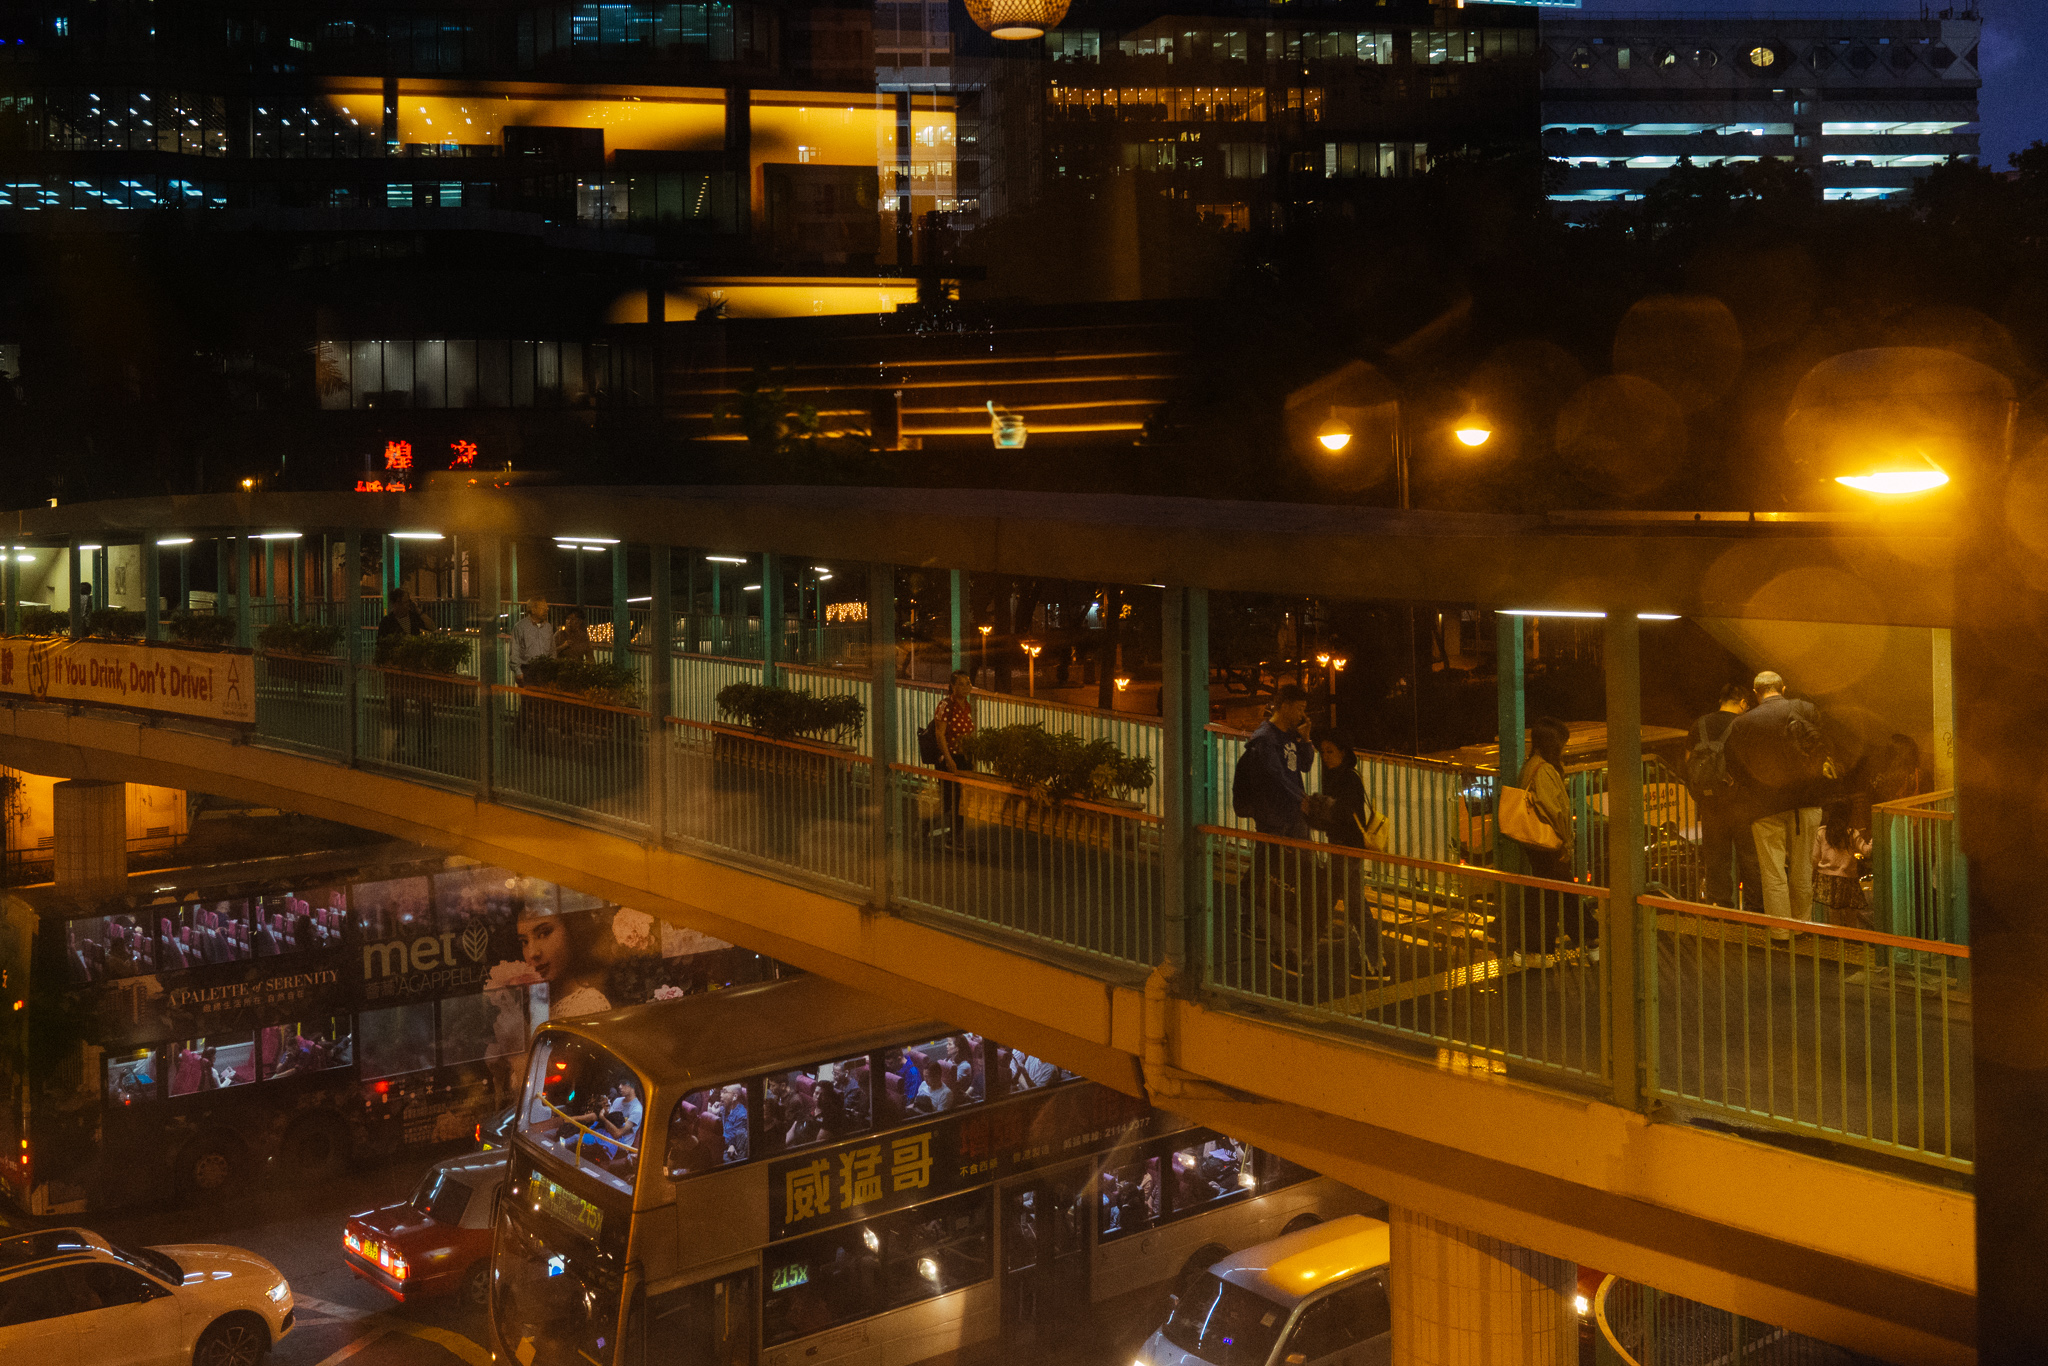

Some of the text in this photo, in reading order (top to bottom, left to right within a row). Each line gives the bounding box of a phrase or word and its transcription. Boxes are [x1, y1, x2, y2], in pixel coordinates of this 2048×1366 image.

[54, 655, 214, 702] If You Drink, Don't Drive!
[363, 932, 458, 980] met
[168, 969, 339, 1007] A PALETTE of SERENITY
[398, 965, 492, 995] ACAPPELLA
[1104, 1123, 1127, 1138] 2114
[785, 1131, 934, 1224] 威猛哥
